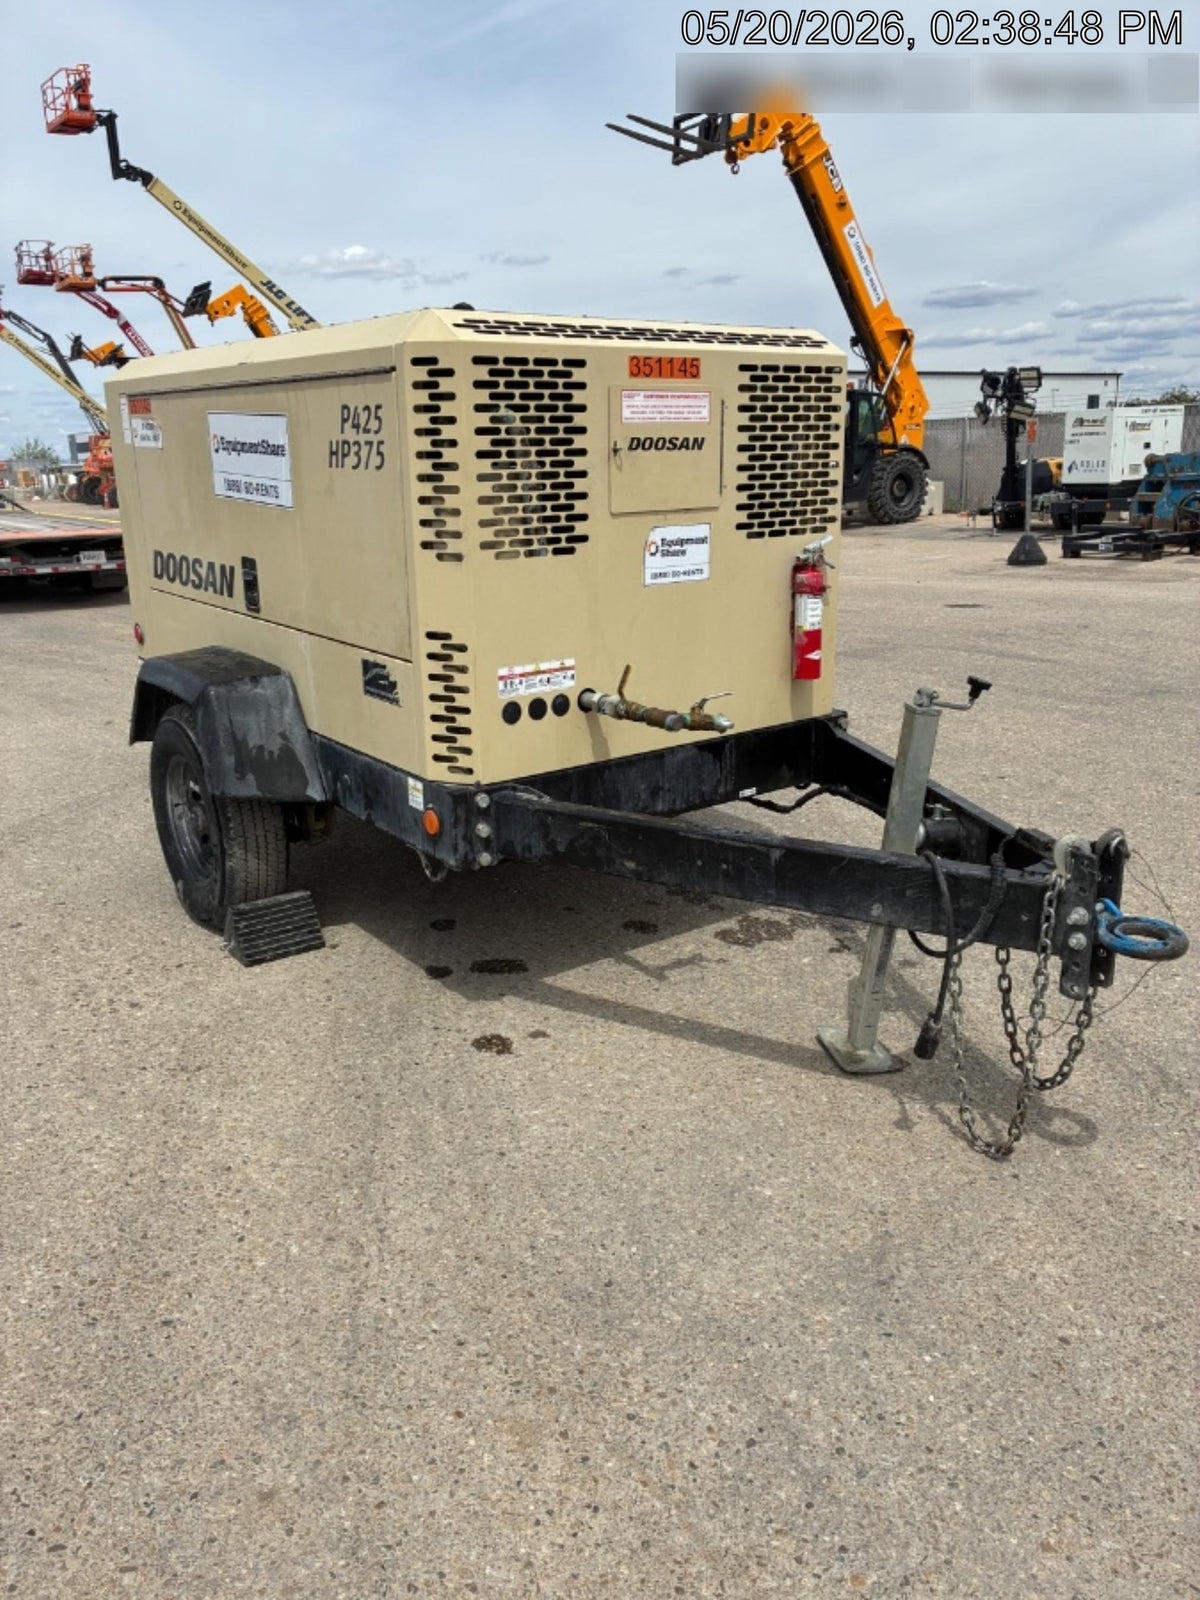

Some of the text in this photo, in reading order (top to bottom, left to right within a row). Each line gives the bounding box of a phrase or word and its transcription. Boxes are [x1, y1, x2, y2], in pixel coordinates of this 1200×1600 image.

[822, 155, 844, 193] JCB
[181, 207, 248, 269] EquipmentShare
[259, 280, 287, 300] JLG
[285, 301, 317, 325] LIFT
[629, 356, 700, 378] 351145
[341, 404, 383, 435] P425
[220, 435, 286, 457] EquipmentShare
[328, 439, 385, 471] HP375
[627, 437, 706, 451] DOOSAN
[660, 536, 709, 548] Equipment
[660, 549, 687, 558] Share
[153, 549, 235, 599] DOOSAN
